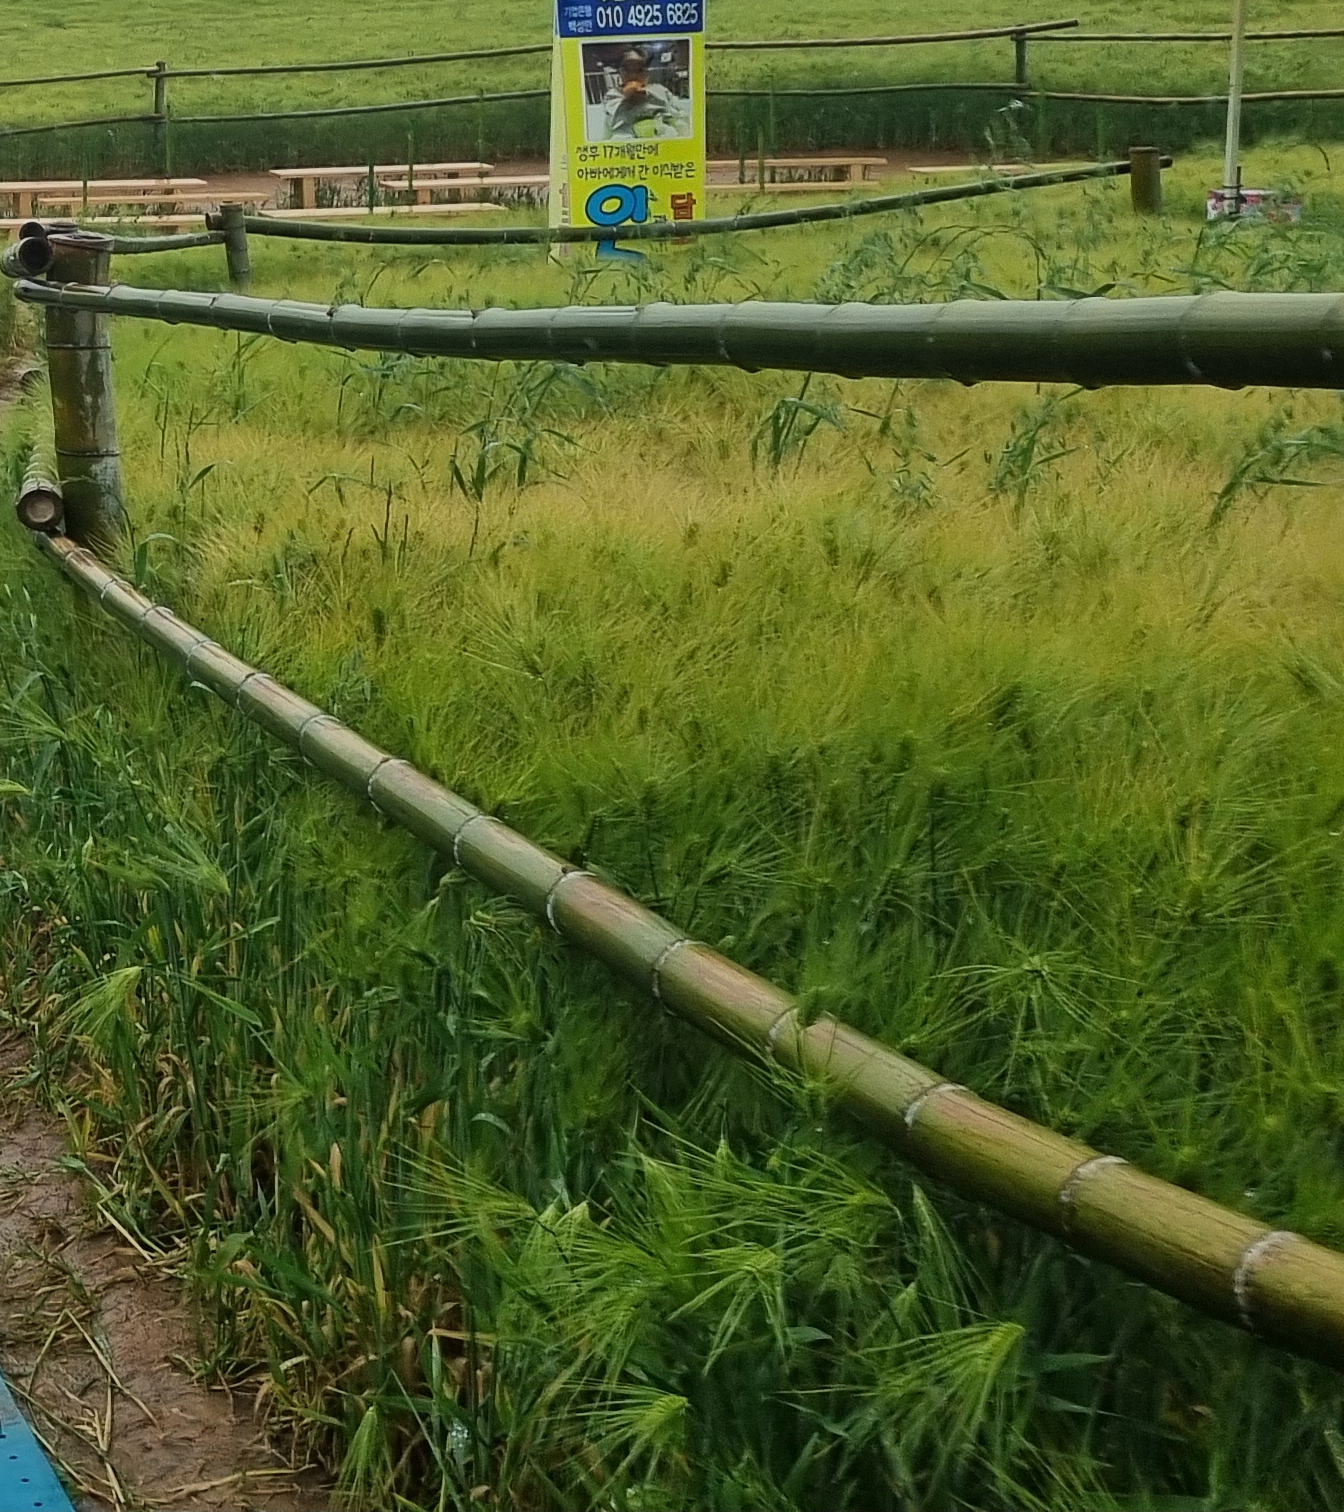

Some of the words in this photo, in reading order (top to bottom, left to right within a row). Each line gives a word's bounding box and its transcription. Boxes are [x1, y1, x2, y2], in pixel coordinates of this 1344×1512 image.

[564, 5, 592, 18] 기업은행
[596, 5, 623, 28] 010
[627, 4, 663, 27] 4925
[666, 2, 699, 25] 6825
[576, 145, 599, 162] 생후
[602, 143, 659, 161] 17개월만에
[577, 166, 635, 181] 아빠에게서
[638, 164, 650, 181] 간
[652, 162, 696, 179] 이식받은
